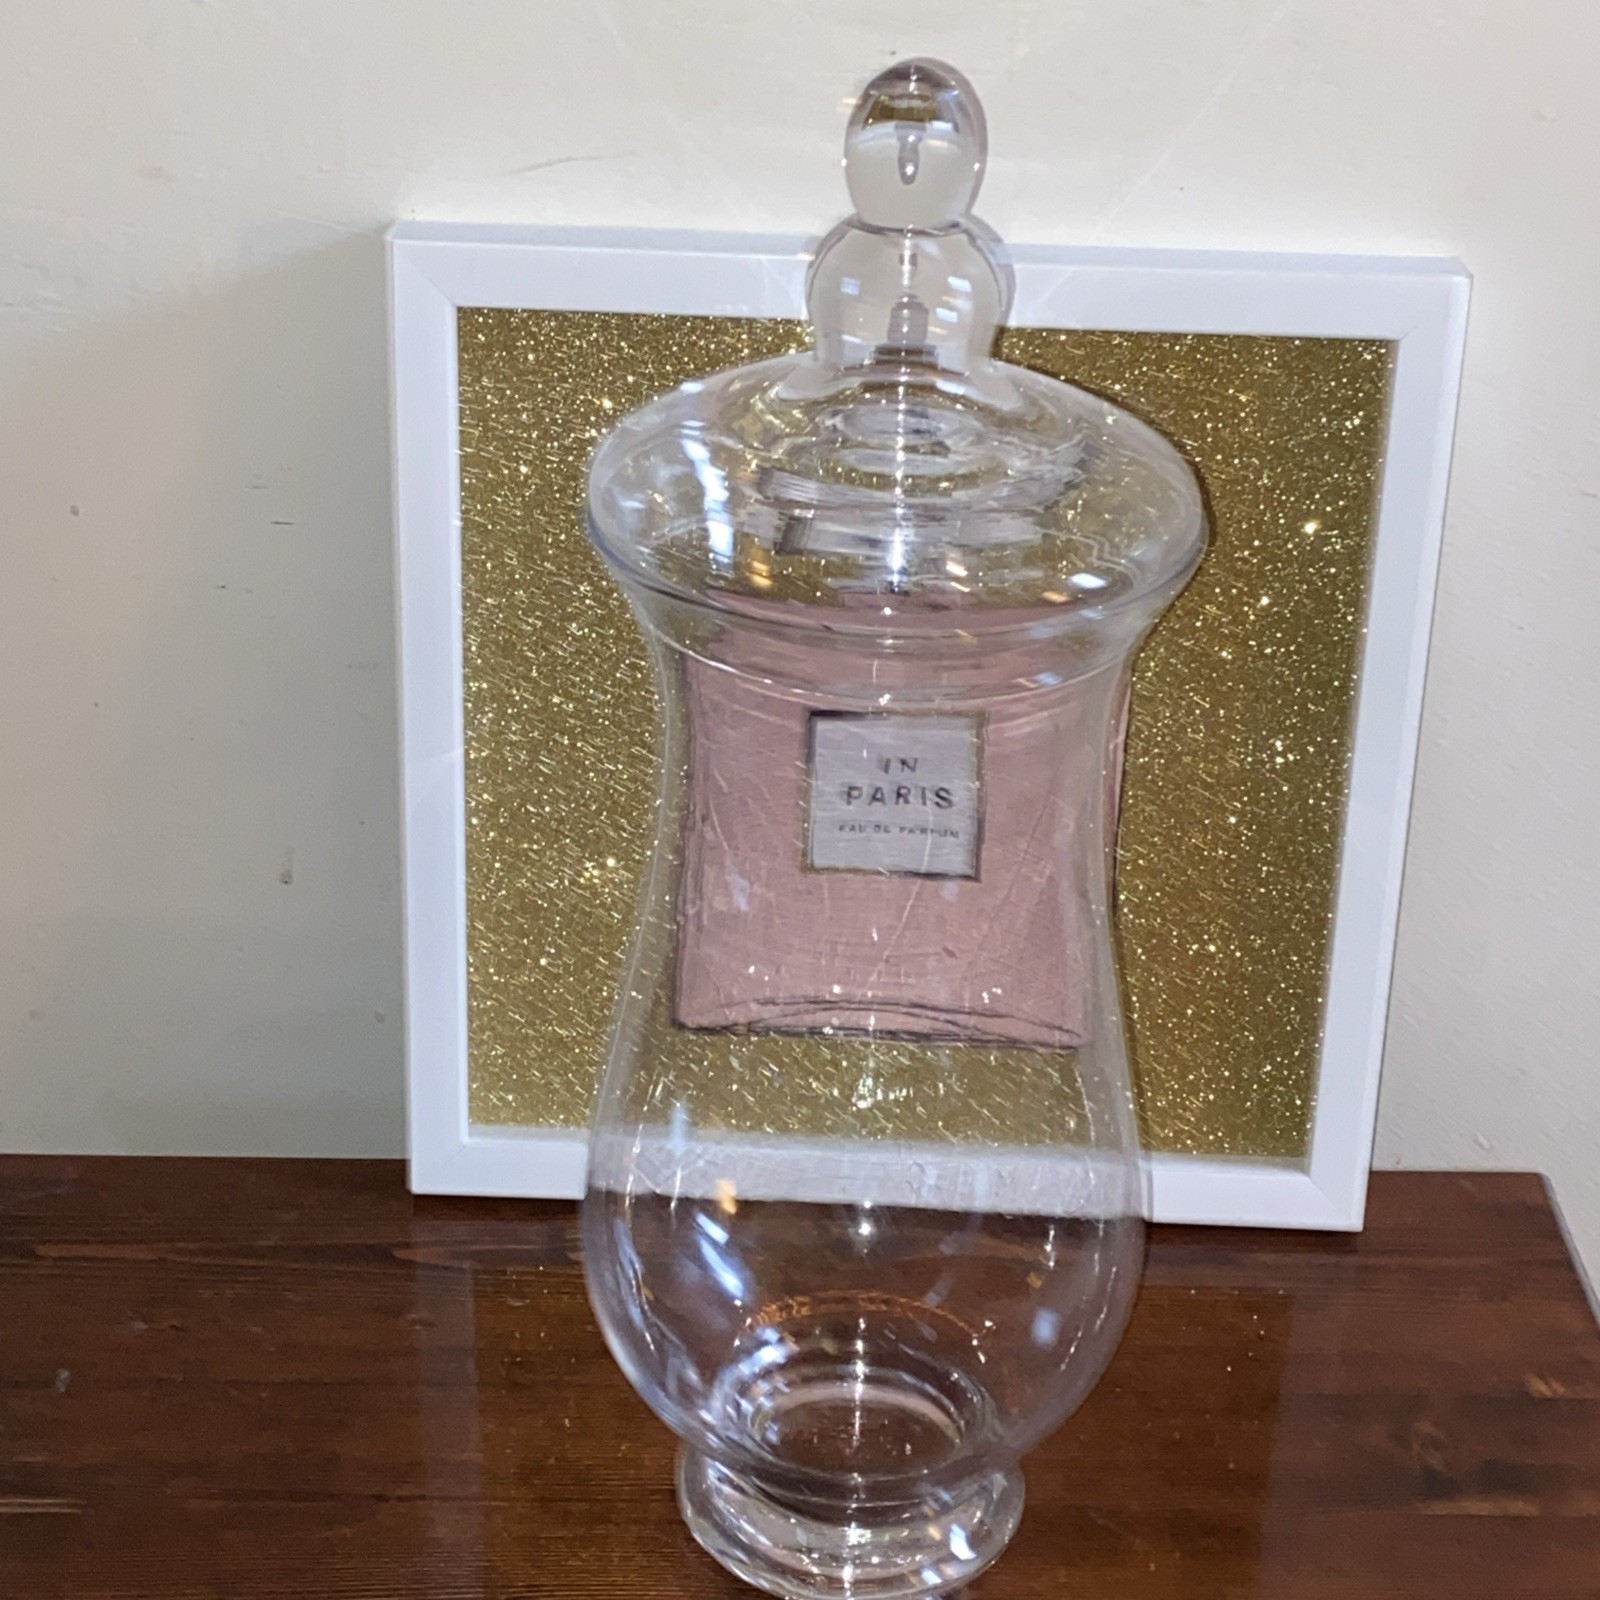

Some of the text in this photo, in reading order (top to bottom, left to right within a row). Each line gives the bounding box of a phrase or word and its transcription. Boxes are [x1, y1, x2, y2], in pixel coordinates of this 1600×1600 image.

[882, 757, 918, 774] IN
[845, 785, 955, 810] PARIS
[838, 824, 867, 834] EAU
